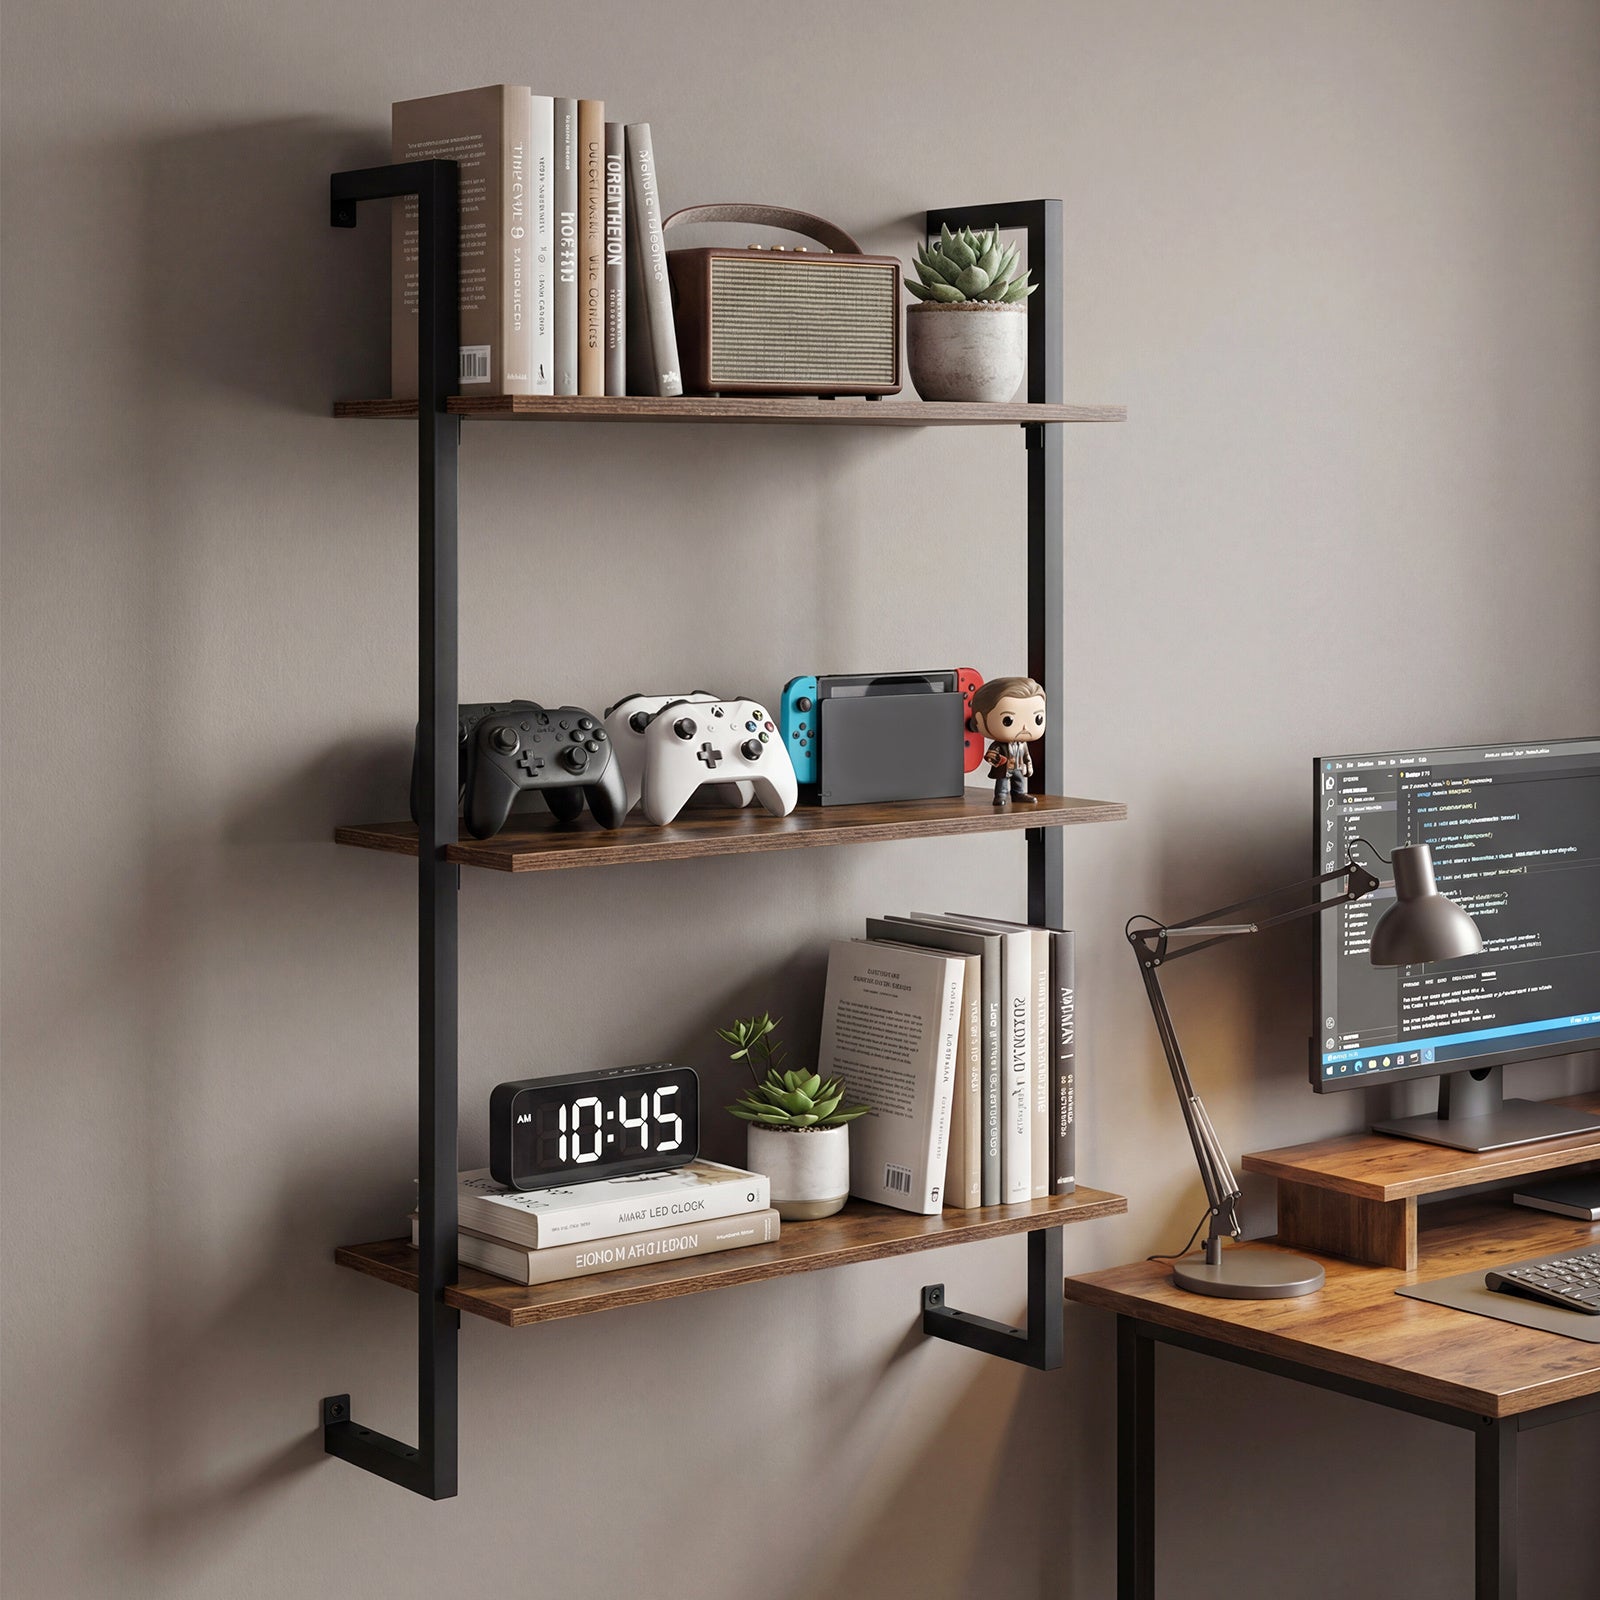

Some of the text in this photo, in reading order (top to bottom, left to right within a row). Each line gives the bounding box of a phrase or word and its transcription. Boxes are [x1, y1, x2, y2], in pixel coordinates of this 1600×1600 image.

[516, 1113, 532, 1124] AM
[558, 1085, 683, 1164] 10:45
[650, 1203, 670, 1219] LED
